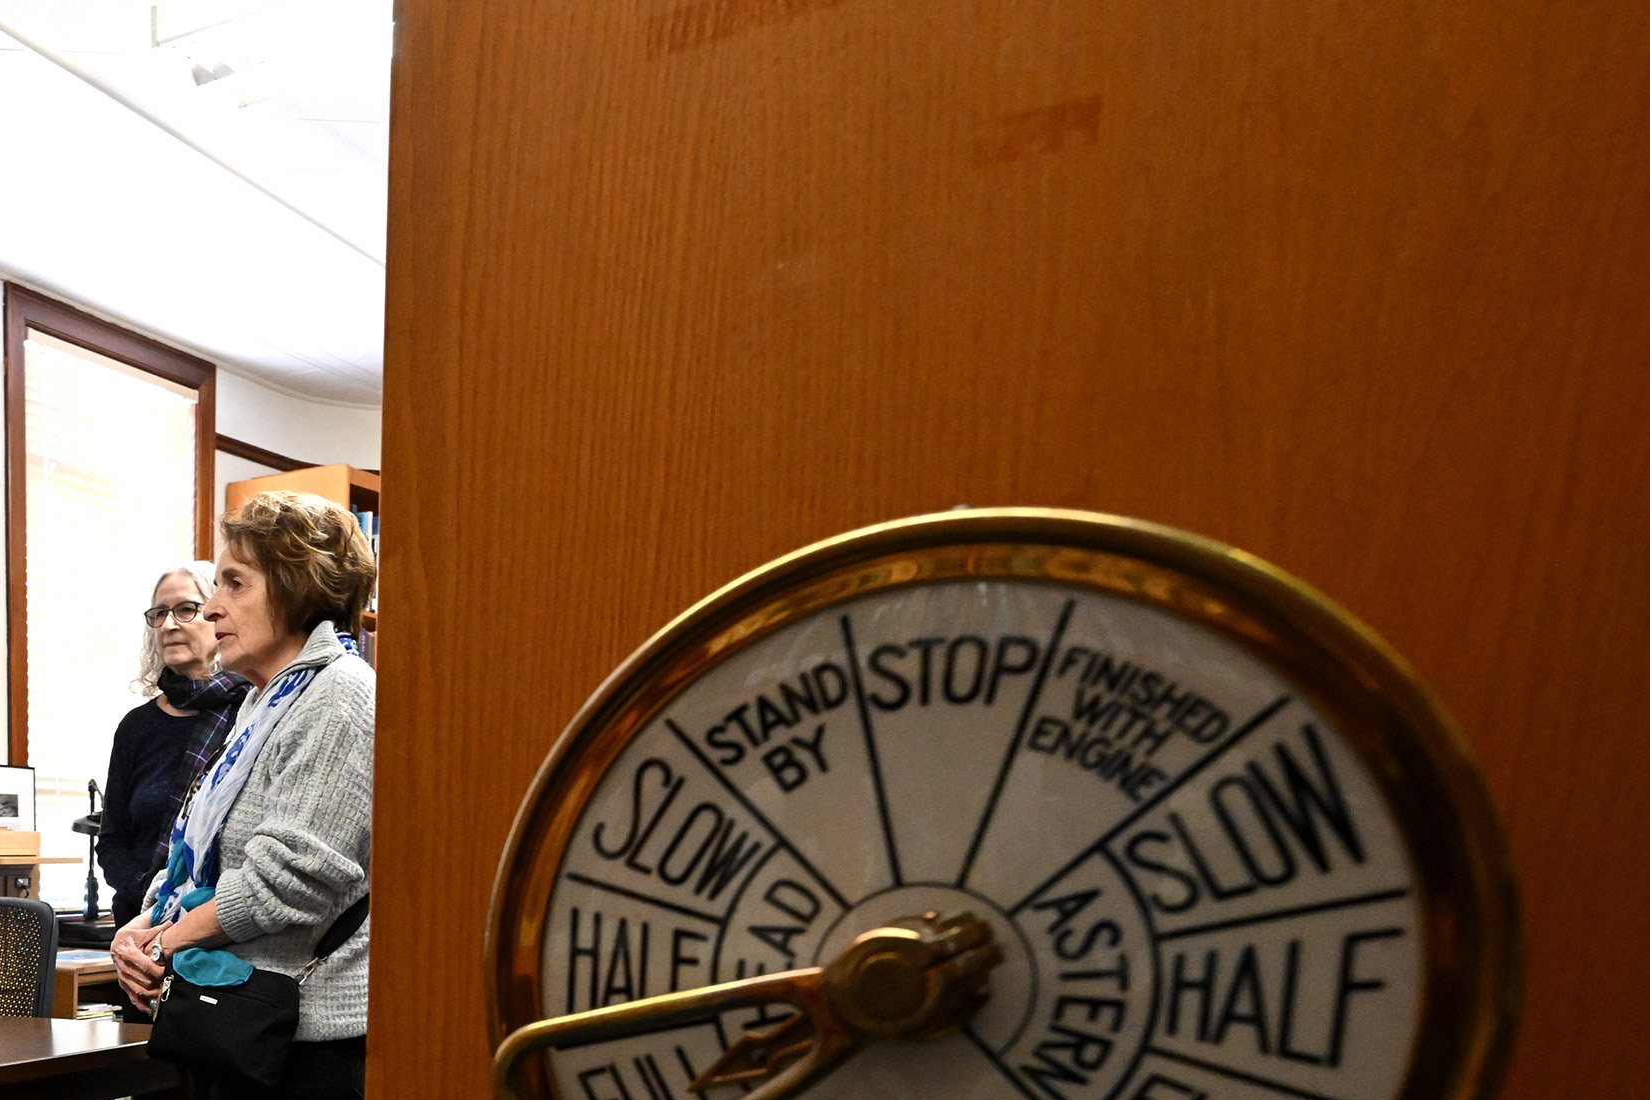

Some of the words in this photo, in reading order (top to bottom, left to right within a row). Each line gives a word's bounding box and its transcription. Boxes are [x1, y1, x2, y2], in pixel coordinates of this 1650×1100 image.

[705, 661, 849, 767] STAND
[867, 634, 1040, 711] STOP
[1055, 646, 1232, 744] FINISHED
[760, 721, 830, 794] BY
[1027, 715, 1170, 803] ENGINE
[1071, 687, 1177, 757] WITH
[591, 757, 763, 902] SLOW
[1123, 722, 1367, 914] SLOW
[1163, 925, 1406, 1070] HALF
